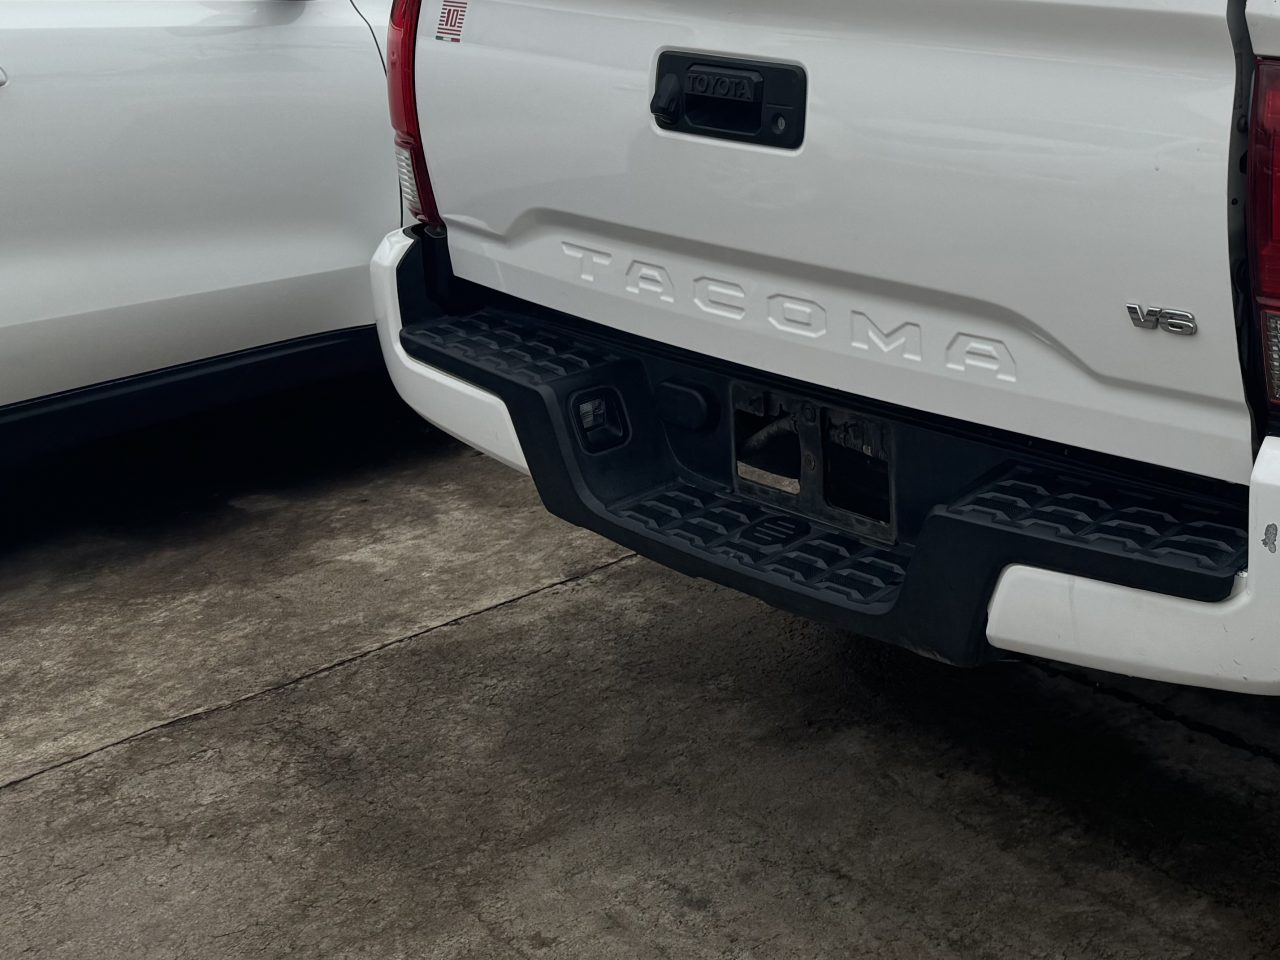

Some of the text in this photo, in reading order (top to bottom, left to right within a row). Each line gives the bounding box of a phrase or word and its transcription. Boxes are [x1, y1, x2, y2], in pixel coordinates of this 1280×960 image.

[687, 73, 752, 100] TOYOTA
[562, 241, 1017, 382] TACOMA
[1125, 303, 1198, 336] V6
